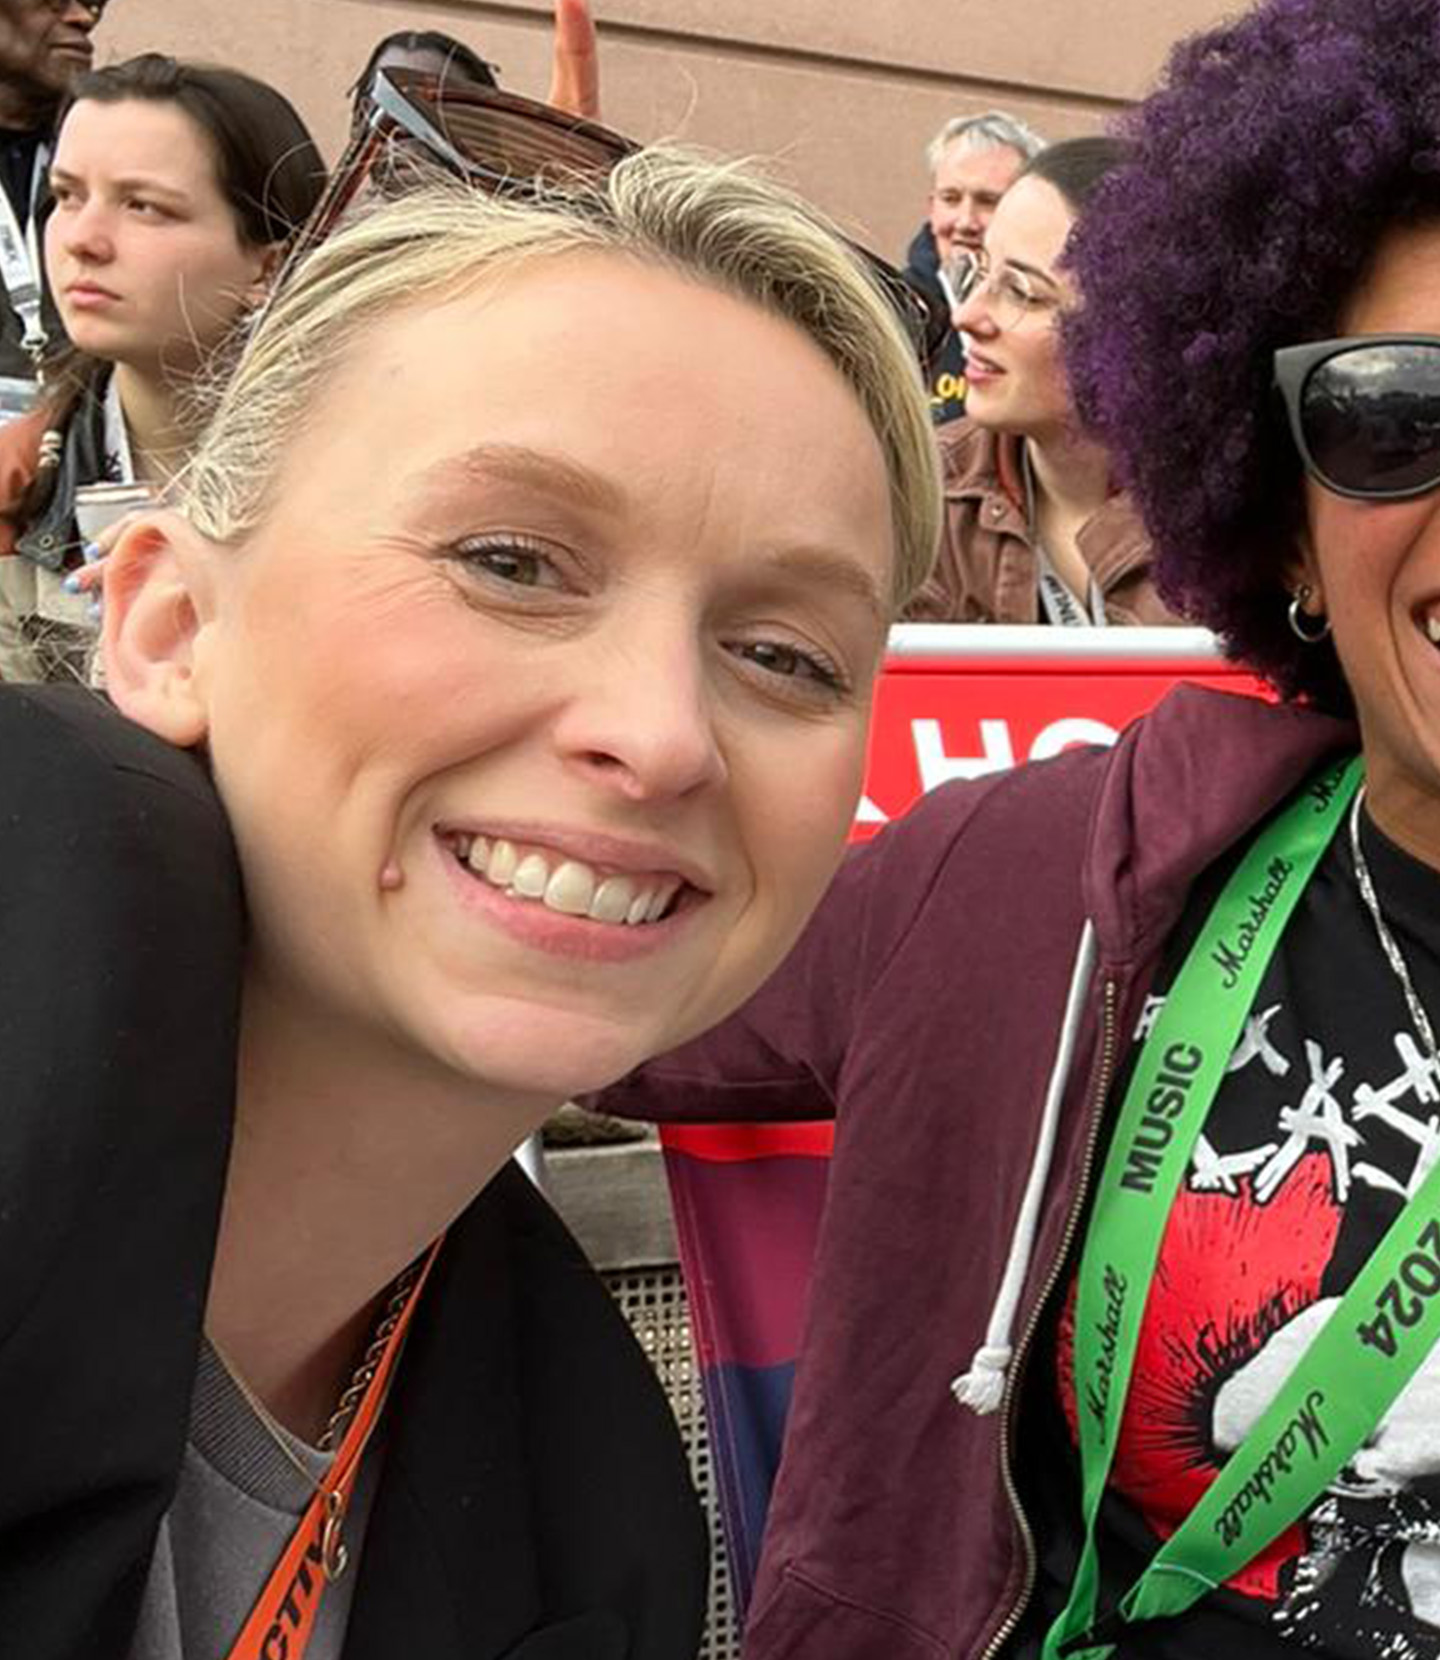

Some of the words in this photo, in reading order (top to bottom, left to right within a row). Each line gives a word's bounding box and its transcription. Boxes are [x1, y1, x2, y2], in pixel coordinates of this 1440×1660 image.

[1212, 856, 1293, 990] Marshall
[1119, 1042, 1204, 1193] MUSIC
[1085, 1263, 1128, 1446] Marshall
[1214, 1388, 1332, 1549] Marshall
